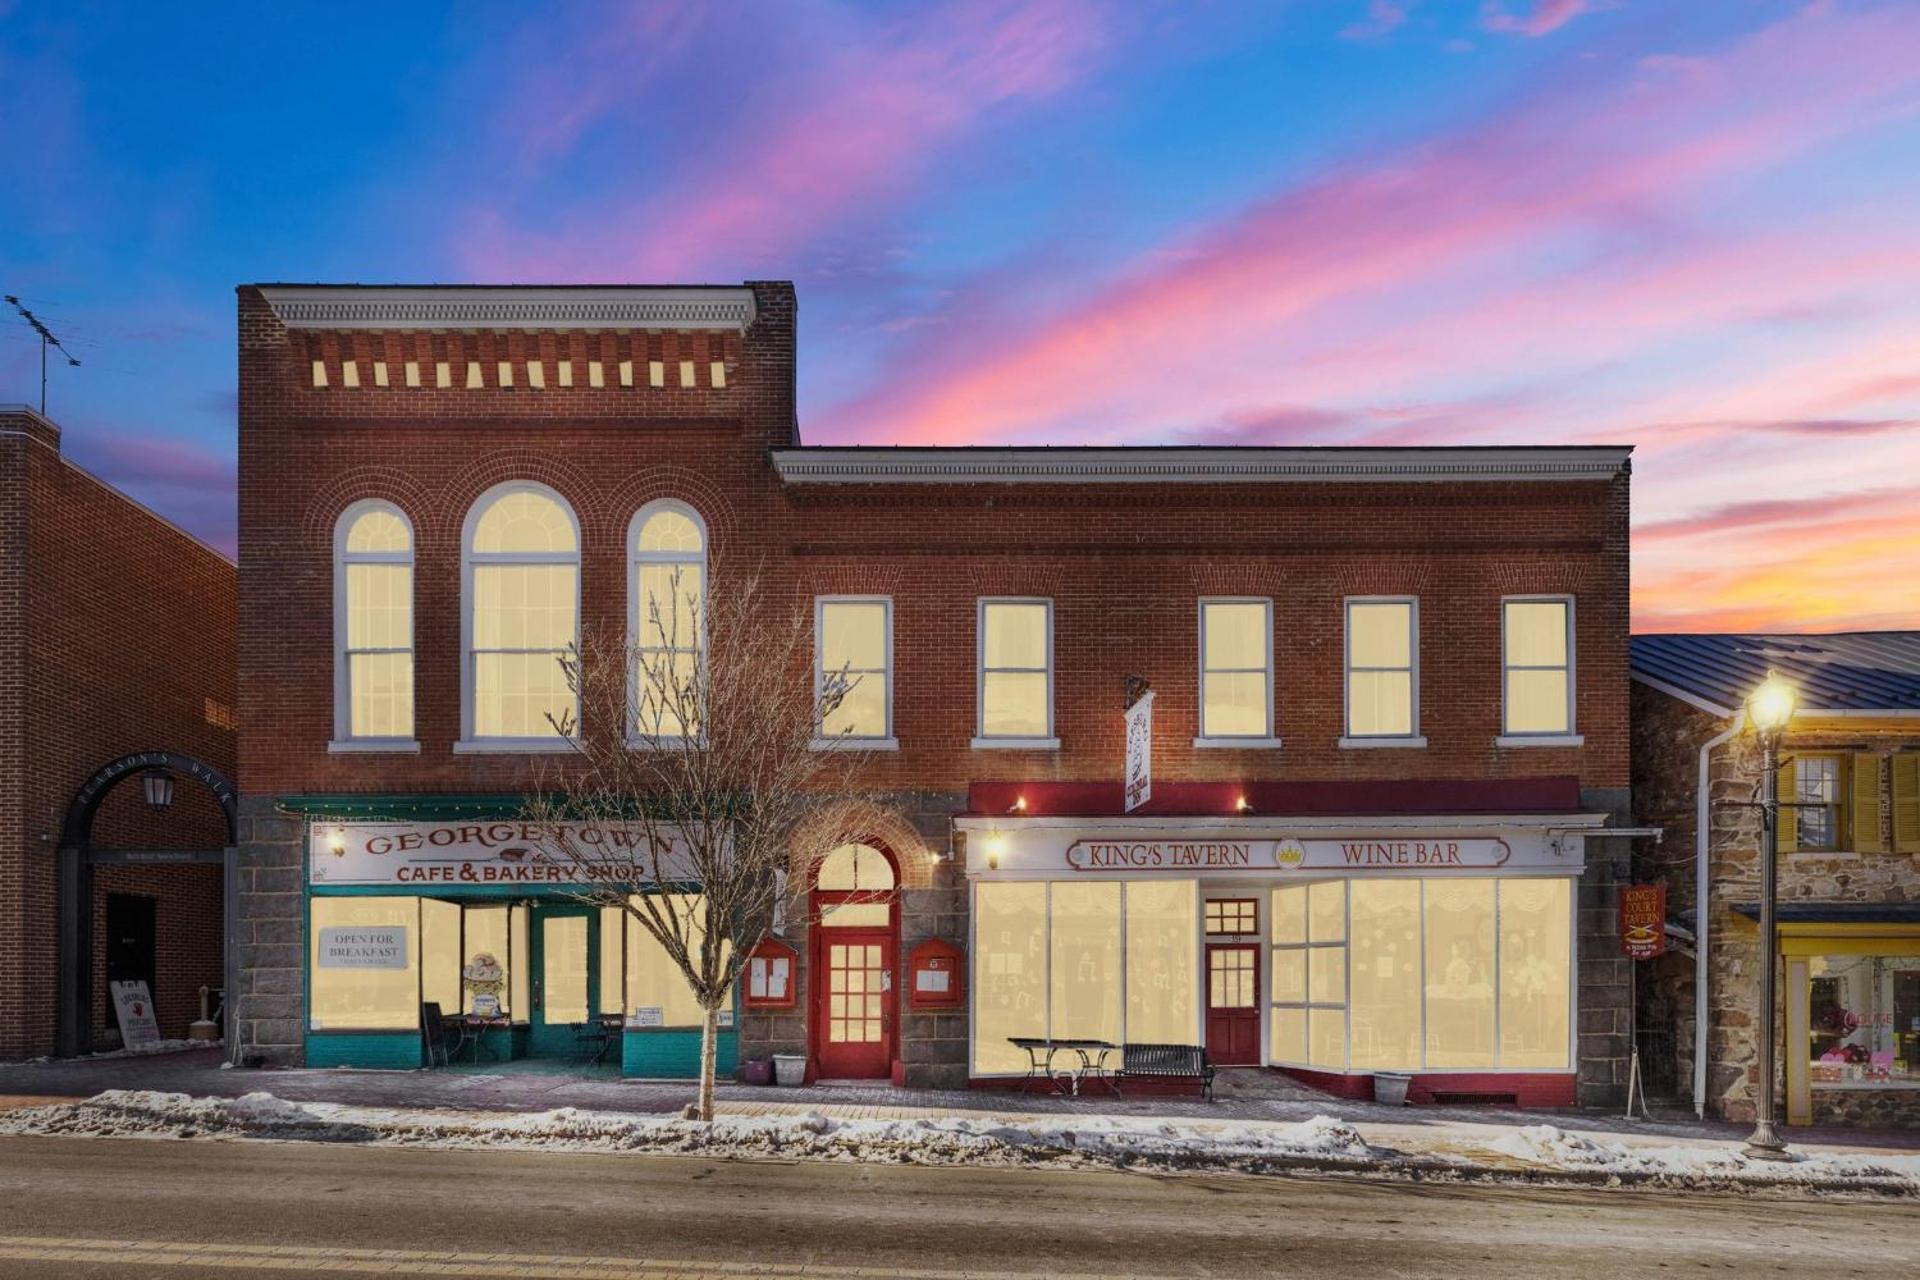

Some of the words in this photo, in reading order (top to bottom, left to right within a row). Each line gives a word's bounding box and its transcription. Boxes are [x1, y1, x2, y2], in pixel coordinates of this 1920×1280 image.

[192, 761, 232, 803] WALK
[366, 824, 678, 855] GEORGETOWN
[1089, 844, 1163, 867] KING'S
[1167, 844, 1250, 867] TAVERN
[1341, 843, 1409, 864] WINE
[1415, 843, 1464, 864] BAR
[396, 866, 454, 882] CAFE
[483, 866, 578, 882] BAKERY
[586, 864, 645, 881] SHOP
[1624, 911, 1660, 925] TAVERN
[334, 934, 368, 944] OPEN
[369, 934, 394, 944] FOR
[328, 947, 399, 957] BREAKFAST
